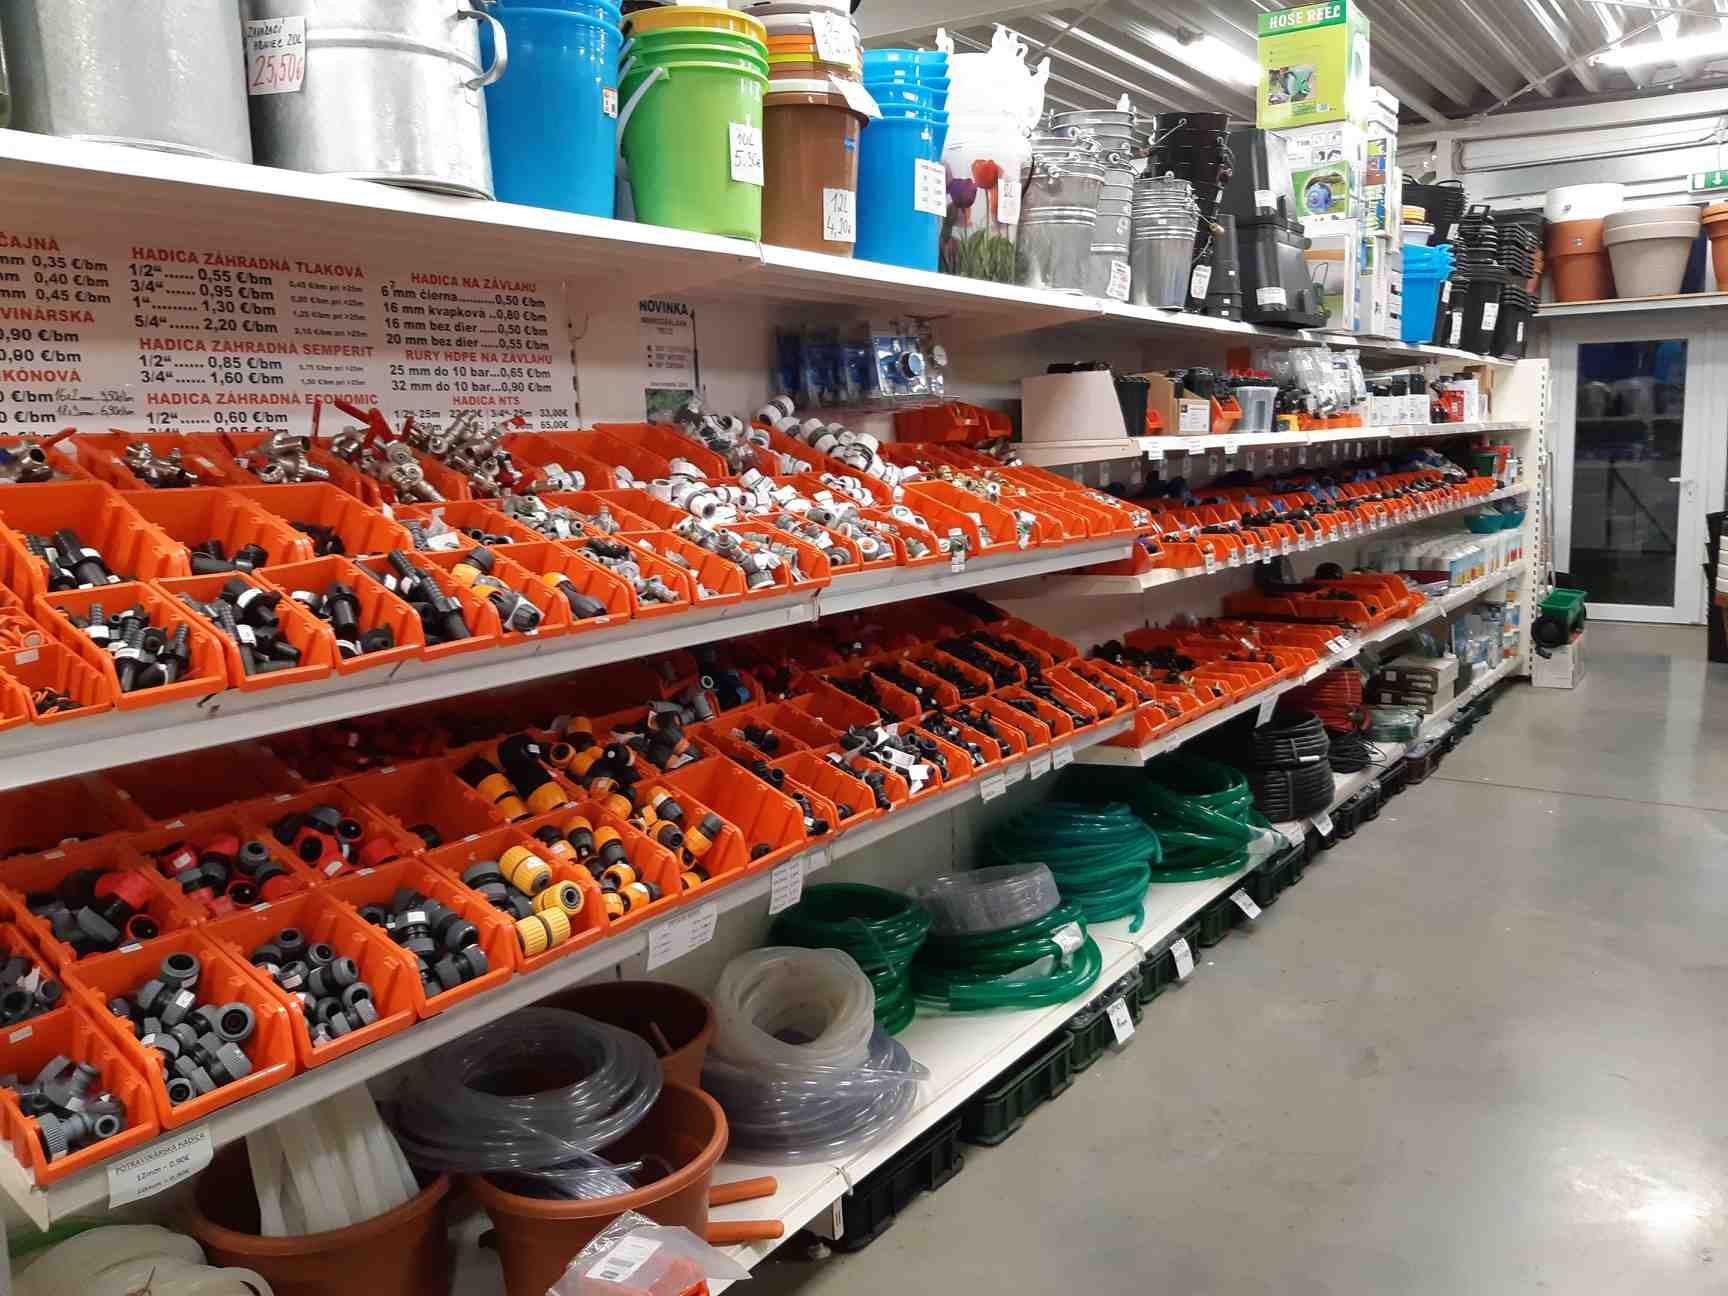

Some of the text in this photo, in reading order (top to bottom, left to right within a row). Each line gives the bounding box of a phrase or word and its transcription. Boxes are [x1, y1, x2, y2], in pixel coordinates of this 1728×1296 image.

[1269, 11, 1303, 29] HOSE
[32, 255, 66, 269] 0,35
[132, 247, 198, 264] HADICA
[34, 272, 68, 285] 0,40
[198, 268, 232, 282] 0,55
[411, 272, 458, 287] HADICA
[462, 278, 480, 289] NA
[36, 289, 69, 302] 0,45
[200, 284, 233, 298] 0,95
[393, 289, 416, 298] mm
[201, 301, 235, 314] 1,30
[384, 302, 398, 313] 16
[402, 306, 425, 315] mm
[640, 300, 688, 316] NOVINKA
[204, 318, 237, 332] 2,20
[385, 318, 400, 329] 16
[403, 321, 426, 330] mm
[430, 321, 451, 331] bez
[454, 321, 477, 332] dier
[386, 333, 402, 345] 20
[405, 336, 428, 345] mm
[431, 336, 452, 346] bez
[456, 336, 478, 347] dier
[140, 338, 207, 351] HADICA
[303, 343, 374, 357] SEMPERIT
[207, 356, 241, 370] 0,85
[445, 351, 477, 362] HDPE
[481, 352, 498, 363] NA
[390, 364, 405, 376] 25
[408, 367, 431, 376] mm
[434, 366, 449, 377] do
[453, 366, 466, 377] 10
[210, 372, 243, 385] 1,60
[391, 380, 407, 391] 32
[410, 383, 432, 391] mm
[435, 381, 450, 391] do
[454, 381, 468, 391] 10
[147, 393, 211, 404] HADICA
[453, 395, 496, 406] HADICA
[213, 411, 247, 425] 0,60
